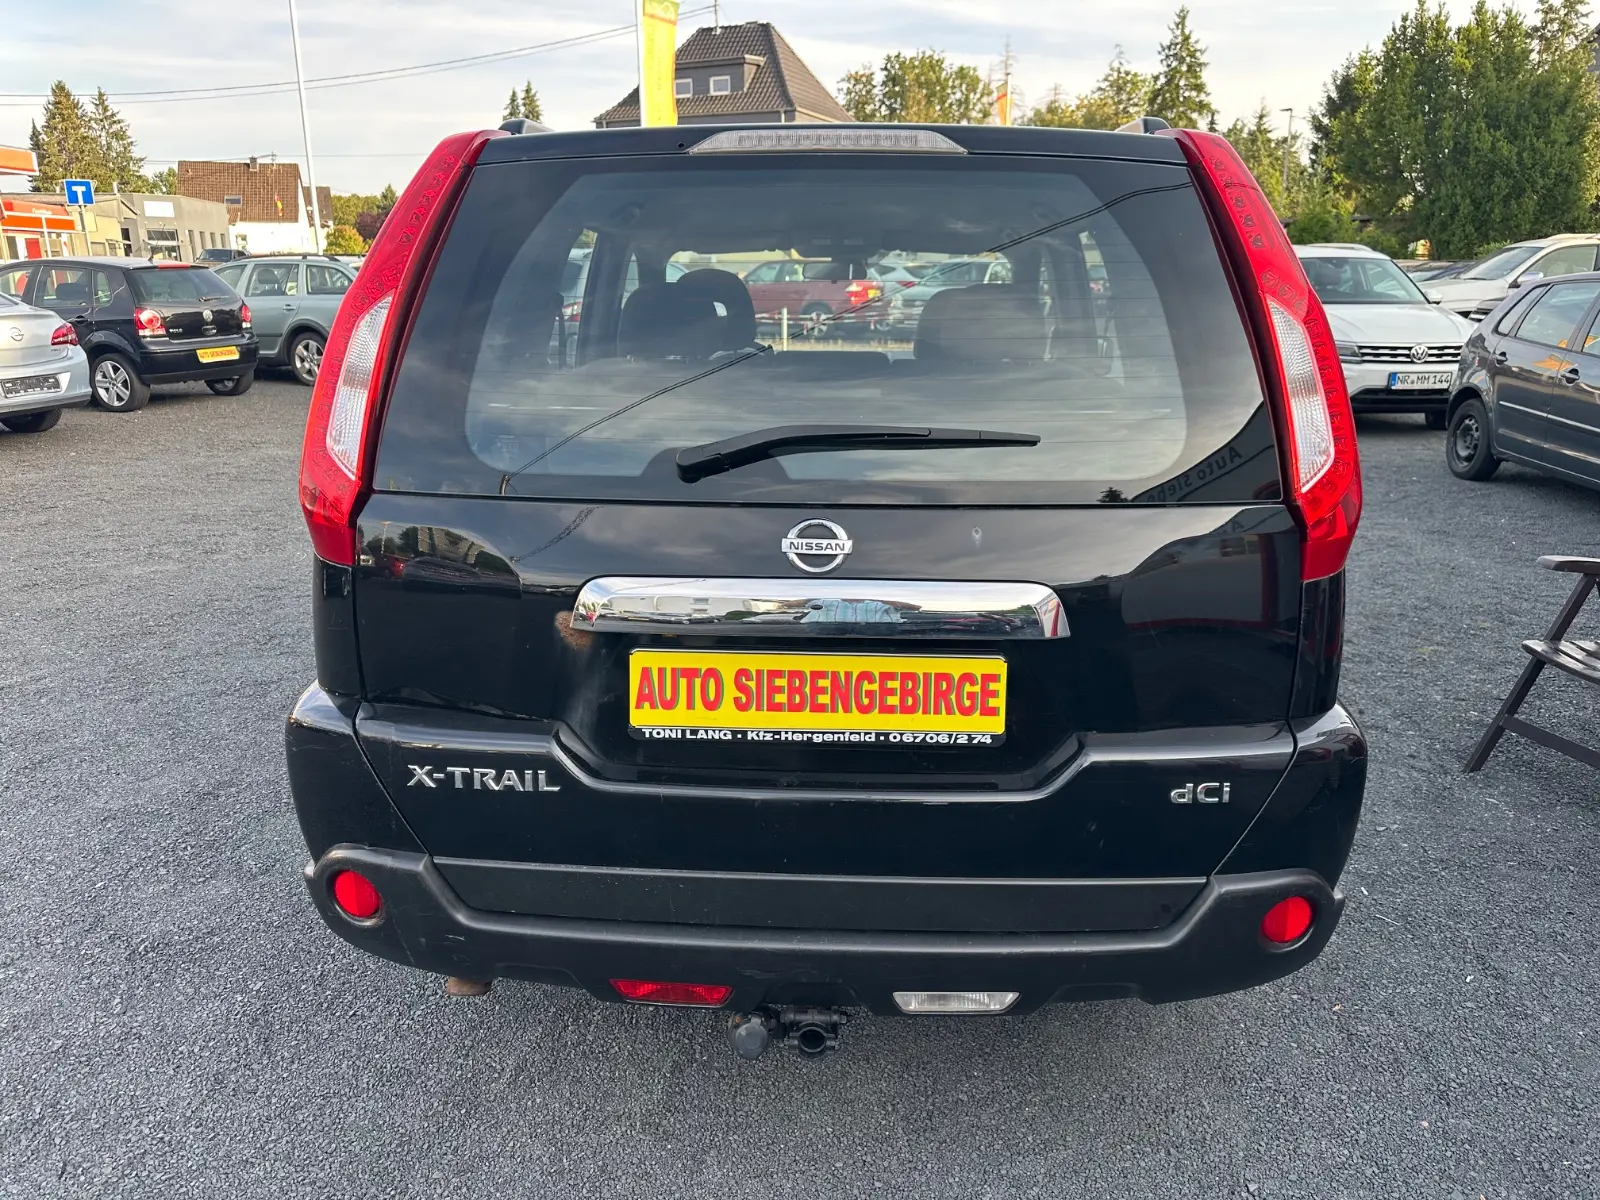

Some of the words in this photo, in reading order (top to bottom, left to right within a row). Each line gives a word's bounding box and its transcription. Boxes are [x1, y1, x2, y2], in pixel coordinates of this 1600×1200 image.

[1397, 374, 1410, 385] NR
[1416, 374, 1430, 385] MM
[1431, 374, 1450, 385] 144
[789, 541, 845, 552] NISSAN
[635, 667, 724, 711] AUTO
[733, 668, 1001, 716] SIEBENGEBIRGE
[642, 728, 682, 739] TONI
[685, 729, 732, 740] LANG
[747, 731, 876, 743] Kfz-Hergenfeld
[406, 764, 561, 792] X-TRAIL
[1170, 782, 1231, 804] dCi
